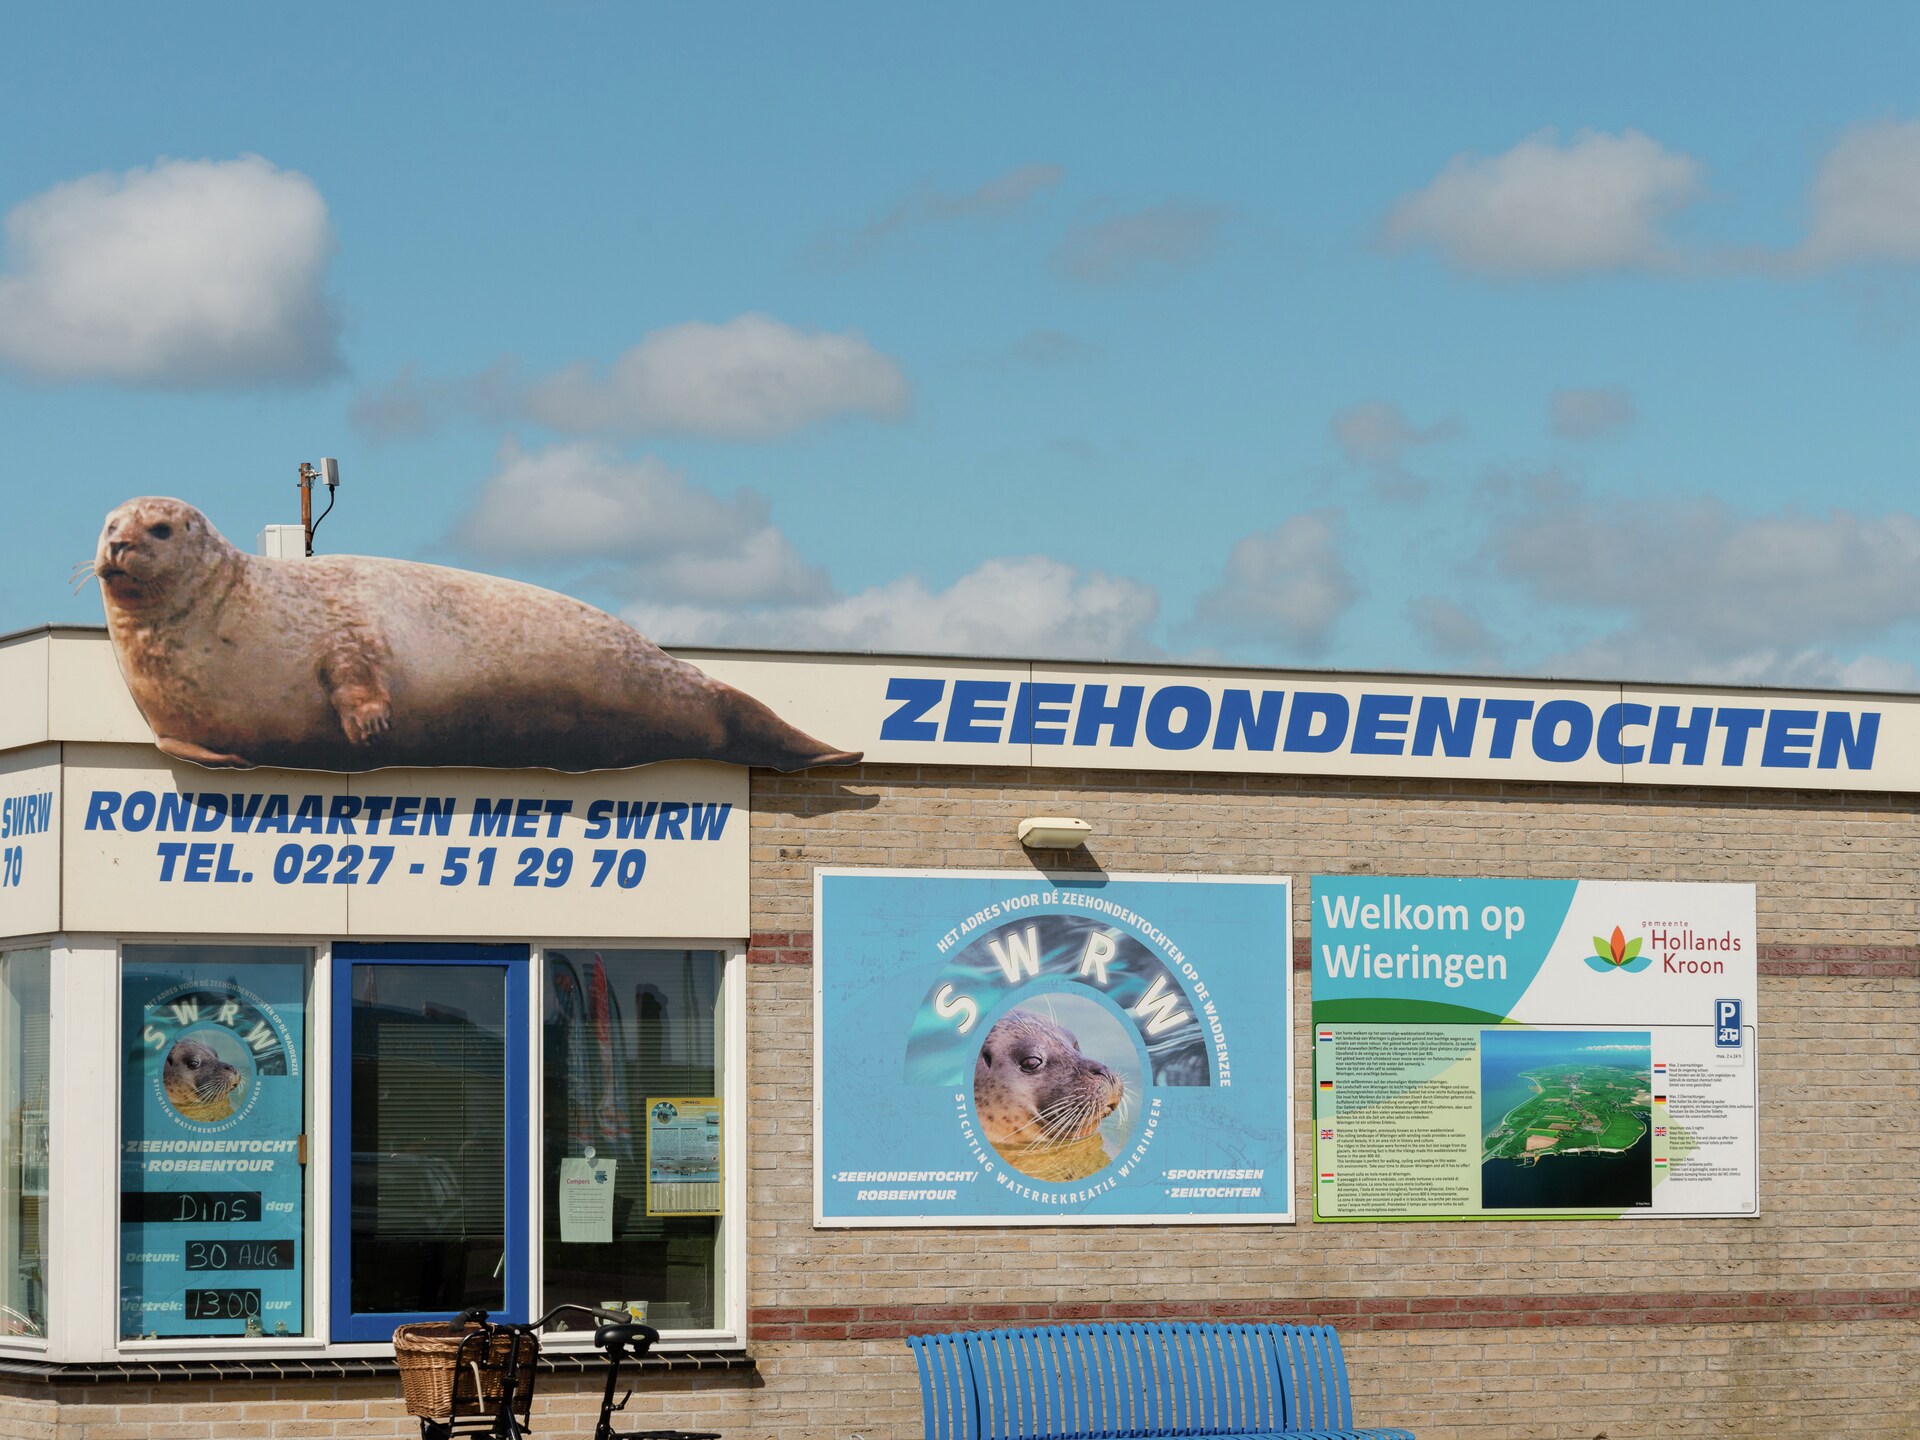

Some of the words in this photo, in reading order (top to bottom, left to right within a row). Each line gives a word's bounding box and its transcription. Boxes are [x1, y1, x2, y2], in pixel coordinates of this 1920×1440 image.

[880, 679, 1880, 770] ZEEHONDENTOCHTEN
[2, 794, 52, 837] SWRW
[86, 792, 455, 836] RONDVAARTEN
[470, 799, 572, 837] MET
[585, 800, 731, 841] SWRW
[4, 847, 22, 885] 70
[158, 843, 252, 883] TEL.
[274, 844, 394, 884] 0227
[441, 848, 496, 886] 51
[515, 848, 572, 887] 29
[592, 850, 645, 889] 70
[1322, 894, 1468, 930] Welkom
[1481, 905, 1525, 939] op
[1652, 930, 1741, 951] Hollands
[1322, 944, 1506, 988] Wieringen
[1664, 953, 1723, 974] Kroon
[936, 928, 959, 954] HET
[960, 904, 1000, 935] ADRES
[1001, 894, 1039, 912] VOOR
[1043, 889, 1058, 904] DÉ
[1062, 892, 1185, 965] ZEEHONDENTOCHTEN
[1182, 963, 1198, 982] OP
[1194, 981, 1209, 1001] DE
[1203, 1000, 1231, 1087] WADDENZEE
[1721, 1003, 1736, 1026] P
[144, 999, 157, 1011] HET
[179, 981, 199, 991] VOOR
[210, 981, 274, 1016] ZEEHONDENTOCHTEN
[273, 1014, 281, 1023] OP
[279, 1023, 287, 1034] DE
[284, 1033, 298, 1076] WADDENZEE
[153, 1078, 173, 1118] STICHTING
[174, 1117, 238, 1134] WATERREKREATIE
[238, 1081, 262, 1120] WIERINGEN
[126, 1140, 297, 1153] ZEEHONDENTOCHT
[955, 1093, 994, 1172] STICHTING
[996, 1172, 1116, 1204] WATERREKREATIE
[1118, 1098, 1161, 1178] WIERINGEN
[148, 1159, 274, 1172] ROBBENTOUR
[1167, 1169, 1264, 1180] SPORTVISSEN
[857, 1190, 957, 1200] ROBBENTOUR
[1170, 1187, 1261, 1198] ZEILTOCHTEN
[265, 1201, 293, 1213] dag
[125, 1252, 179, 1262] Datum:
[189, 1243, 227, 1269] 30
[239, 1244, 278, 1267] AUG
[122, 1301, 183, 1312] Vertrek:
[265, 1301, 291, 1310] uur
